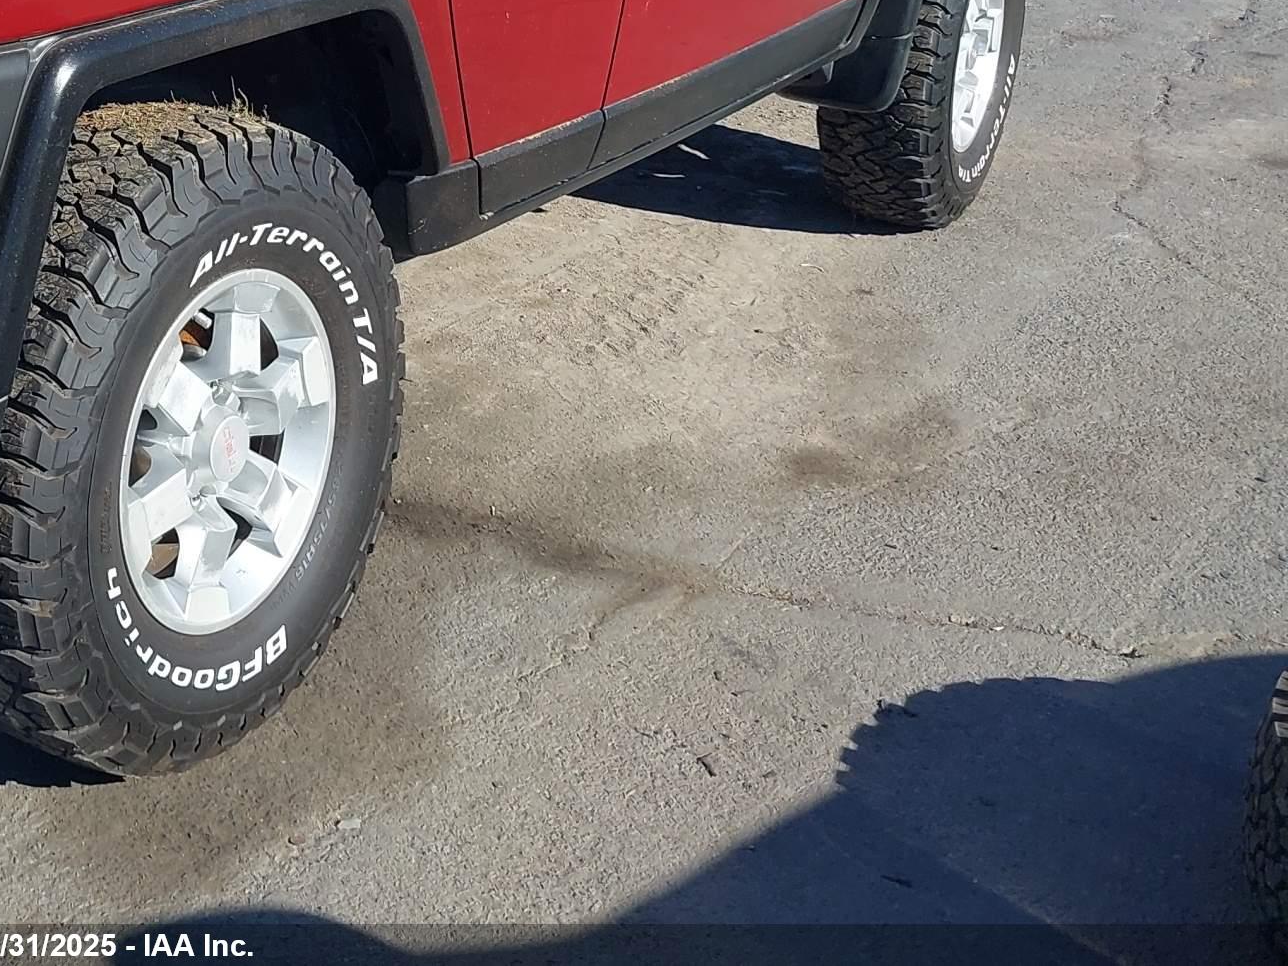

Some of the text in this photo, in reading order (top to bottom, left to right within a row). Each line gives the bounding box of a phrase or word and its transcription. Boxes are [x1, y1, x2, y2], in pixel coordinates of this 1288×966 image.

[190, 223, 378, 386] All-Terrain T/A
[107, 567, 288, 691] BFGoodrich
